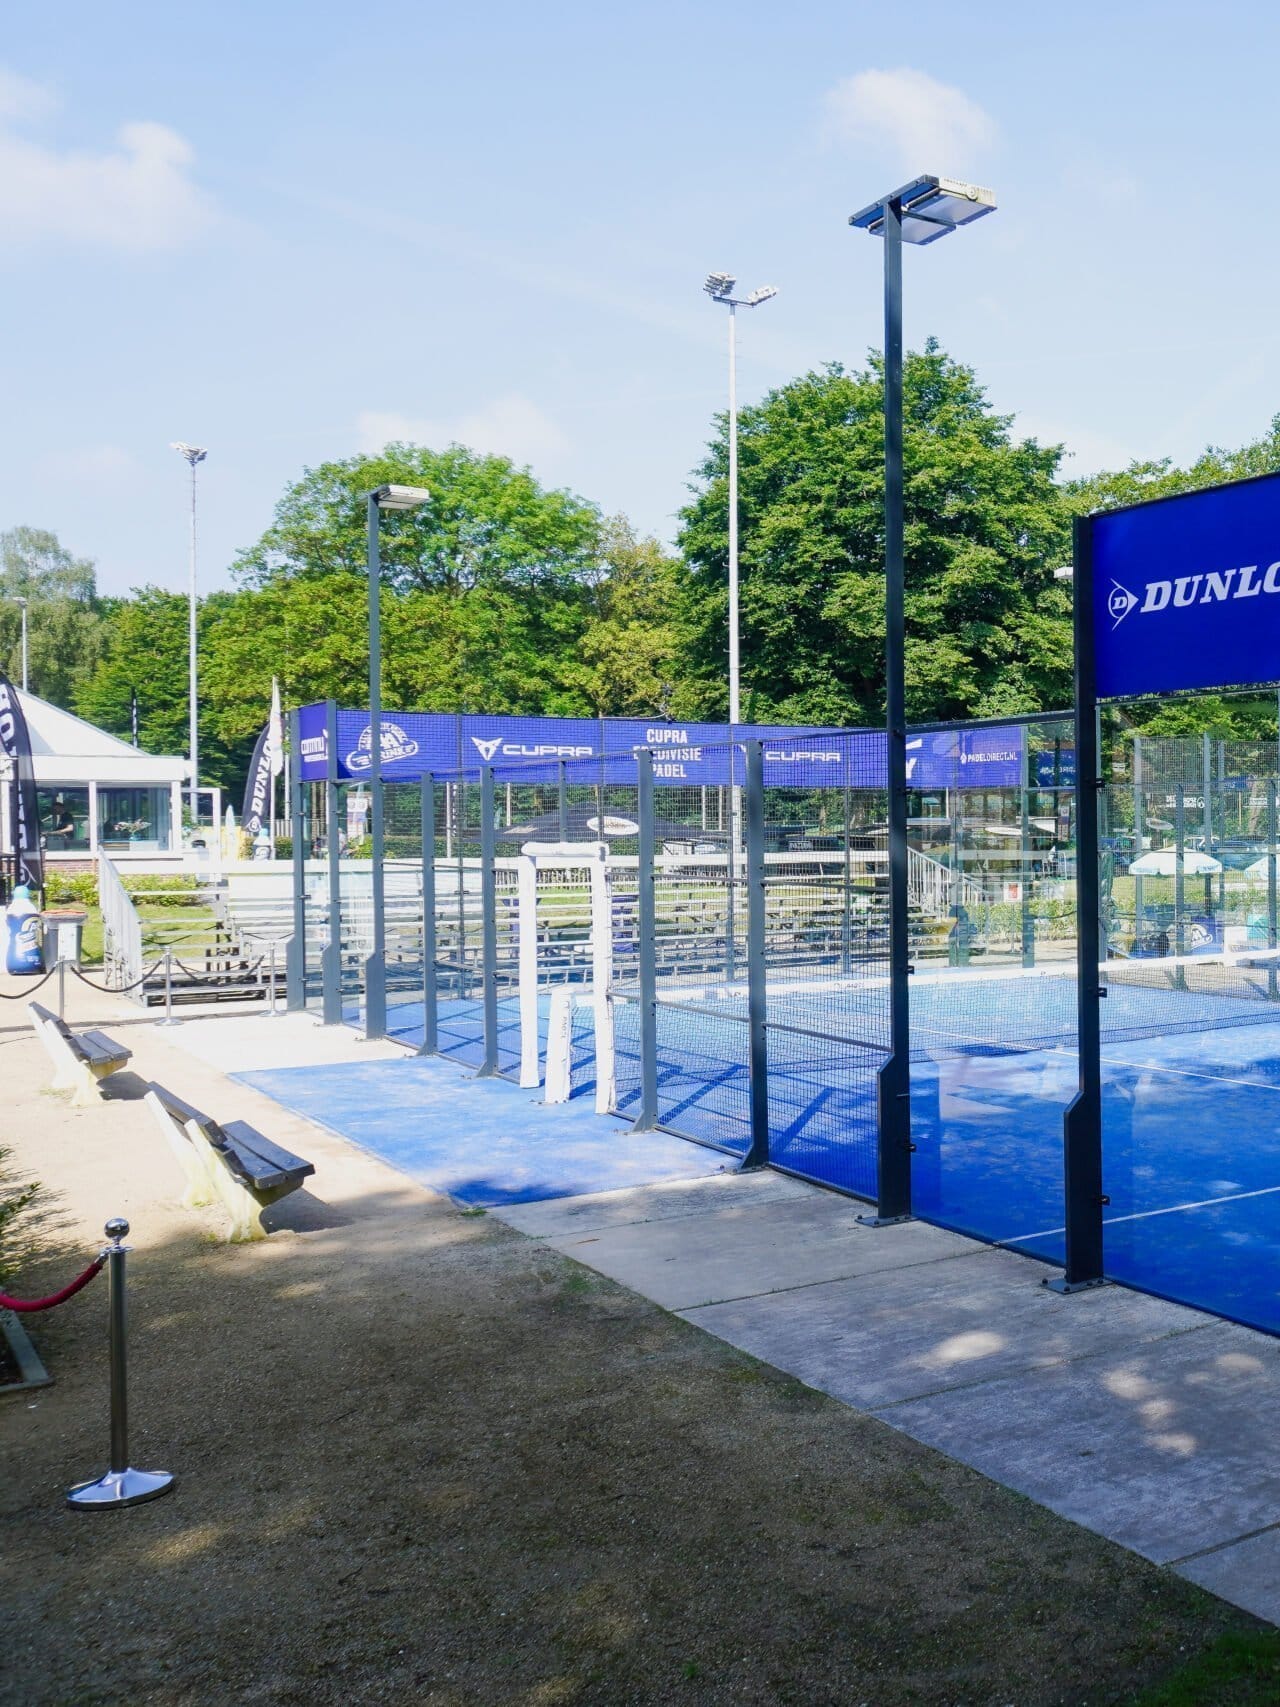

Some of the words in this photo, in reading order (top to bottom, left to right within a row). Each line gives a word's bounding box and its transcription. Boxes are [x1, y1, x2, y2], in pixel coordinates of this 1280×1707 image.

[646, 729, 688, 744] CUPRA
[502, 744, 593, 756] CUPRA
[632, 745, 702, 761] EEDIVISIE
[765, 751, 841, 762] CUPRA
[251, 733, 272, 817] DUNLO
